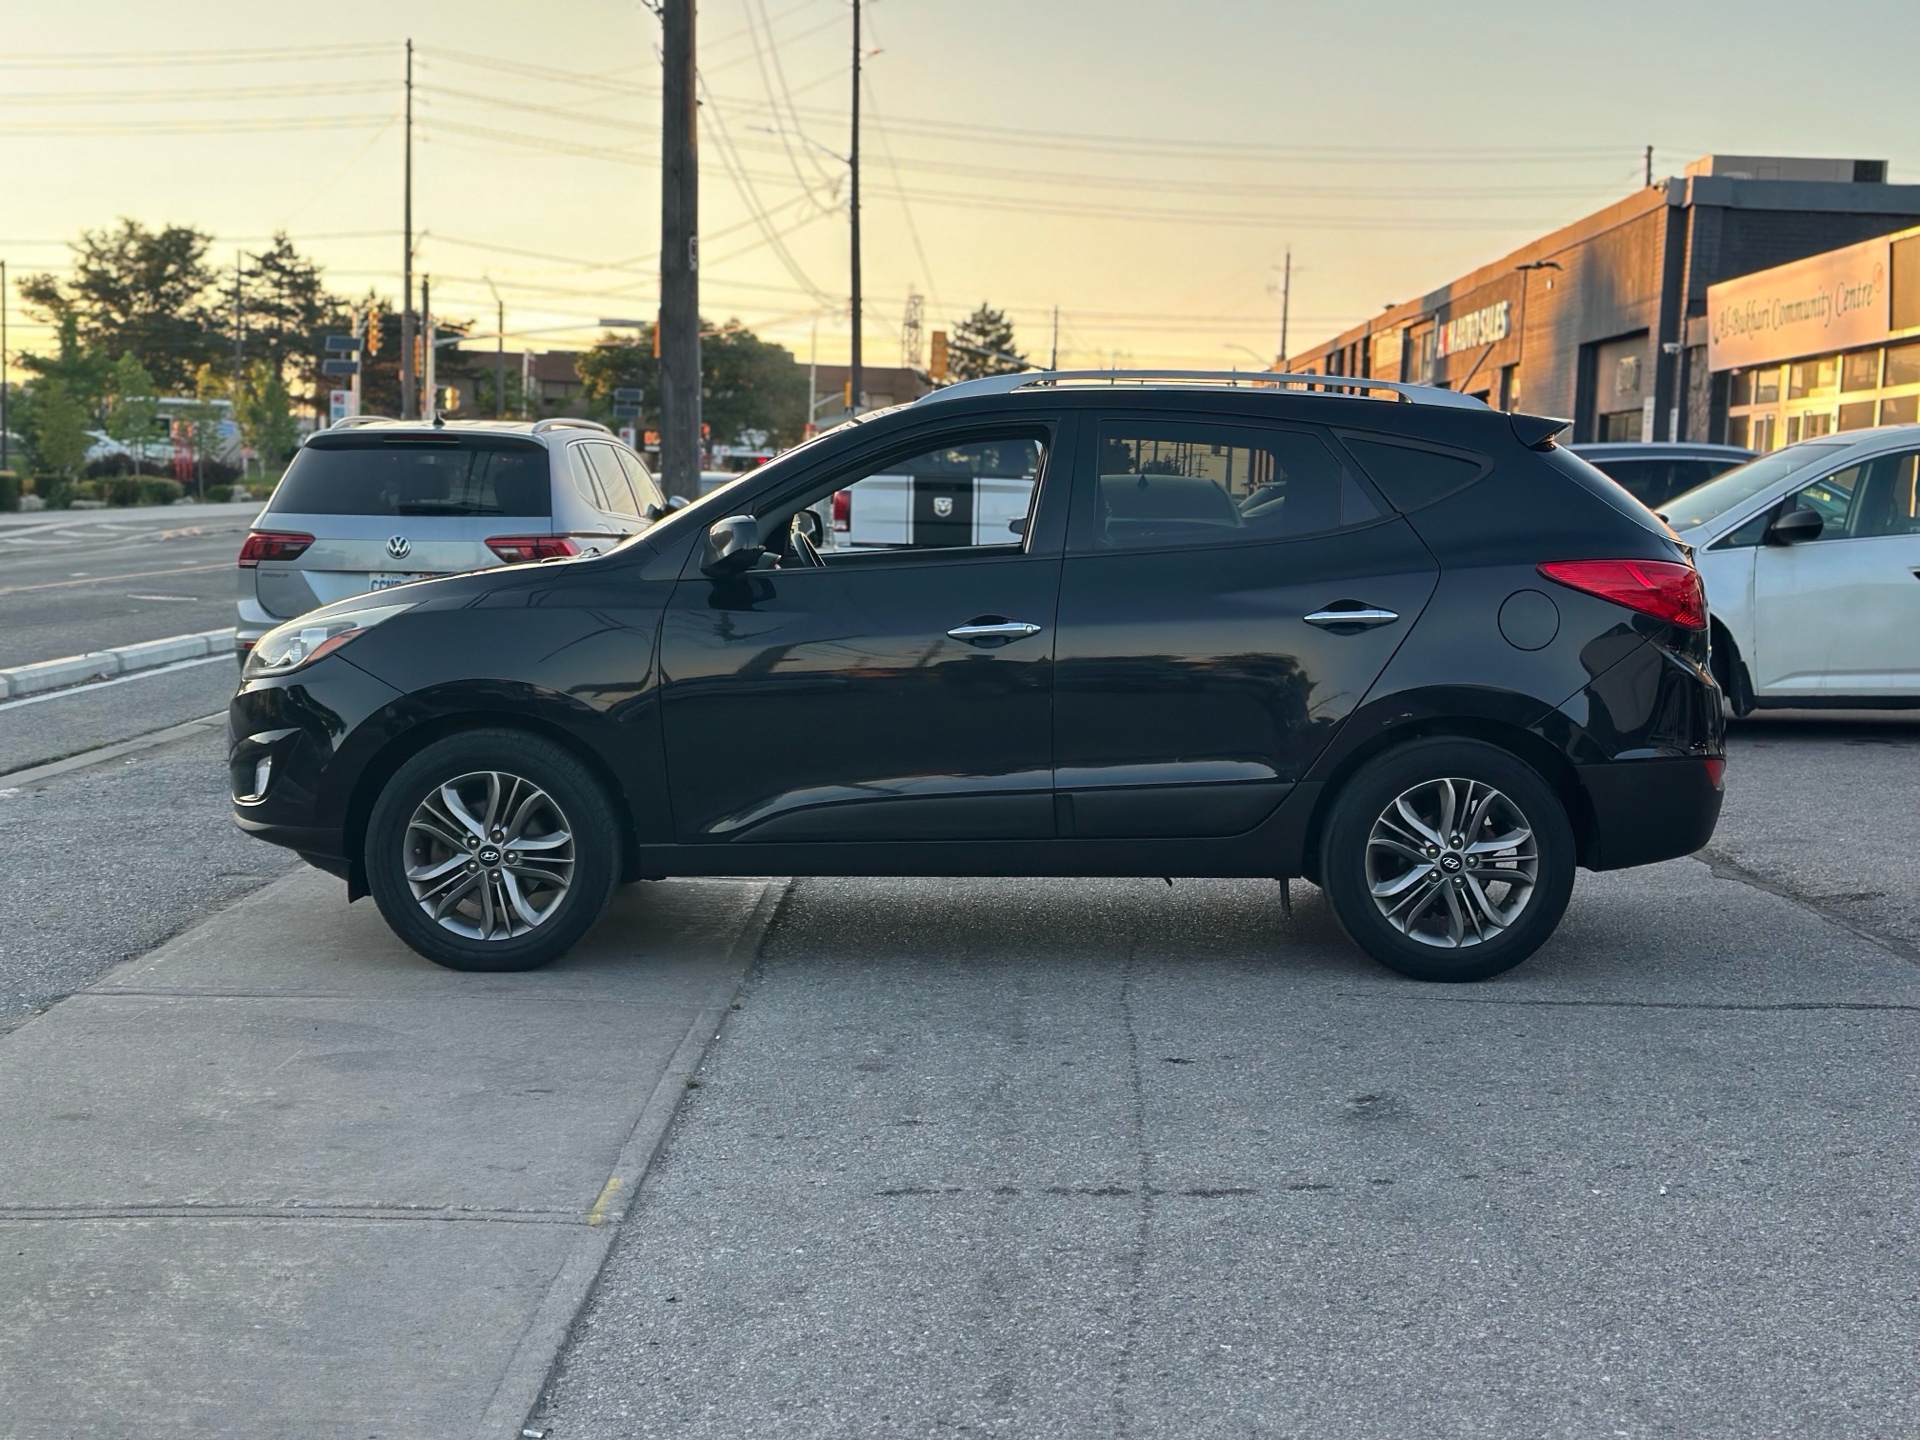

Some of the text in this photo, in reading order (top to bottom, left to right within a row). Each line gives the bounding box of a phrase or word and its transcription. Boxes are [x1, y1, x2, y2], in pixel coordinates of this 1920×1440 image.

[1480, 300, 1510, 345] SALES
[1713, 281, 1872, 345] Al-Bukhari Community Centre
